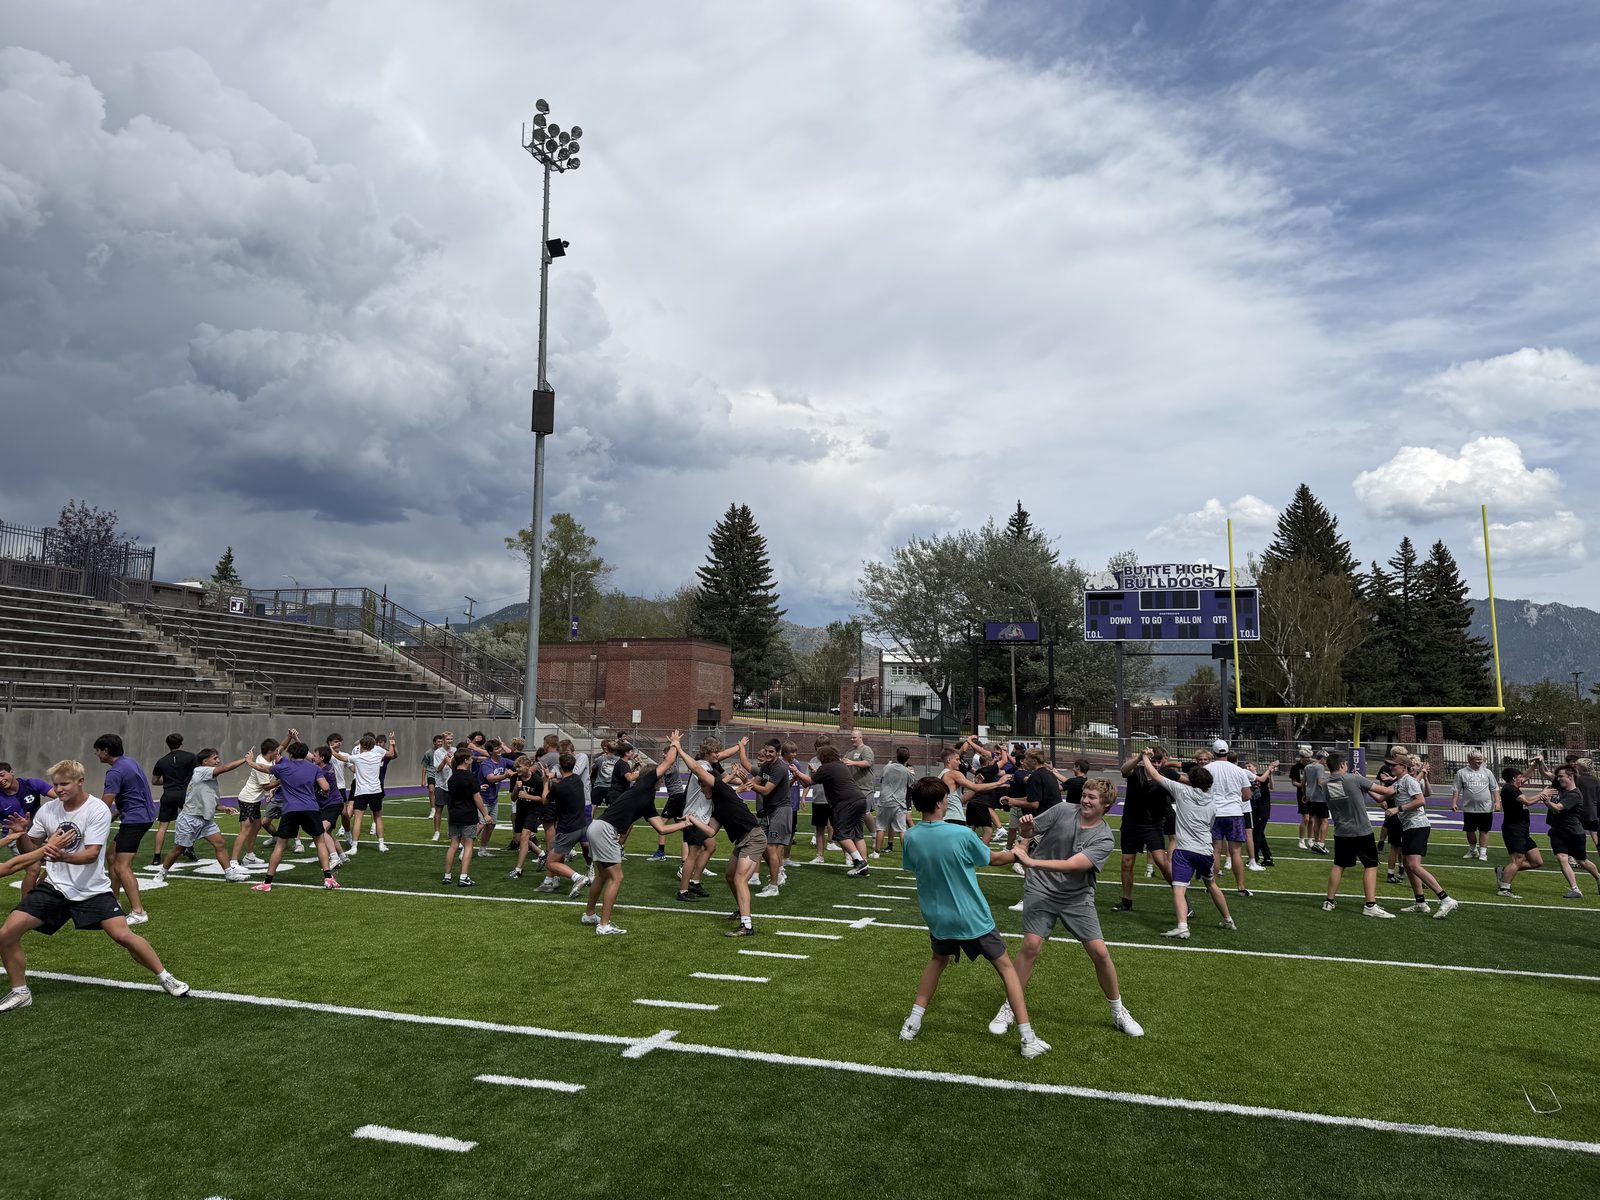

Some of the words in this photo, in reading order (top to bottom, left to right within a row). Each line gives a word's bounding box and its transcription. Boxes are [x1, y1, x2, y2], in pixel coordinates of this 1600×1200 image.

[1124, 565, 1171, 575] BUTTE
[1176, 564, 1213, 574] HIGH
[1124, 577, 1215, 589] BULLDOGS
[1110, 616, 1132, 624] DOWN
[1141, 616, 1150, 624] TO
[1152, 616, 1162, 624] GO
[1174, 616, 1191, 624] BALL
[1192, 616, 1202, 624] ON
[1212, 615, 1228, 624] QTR
[1086, 630, 1103, 638] T.O.L.
